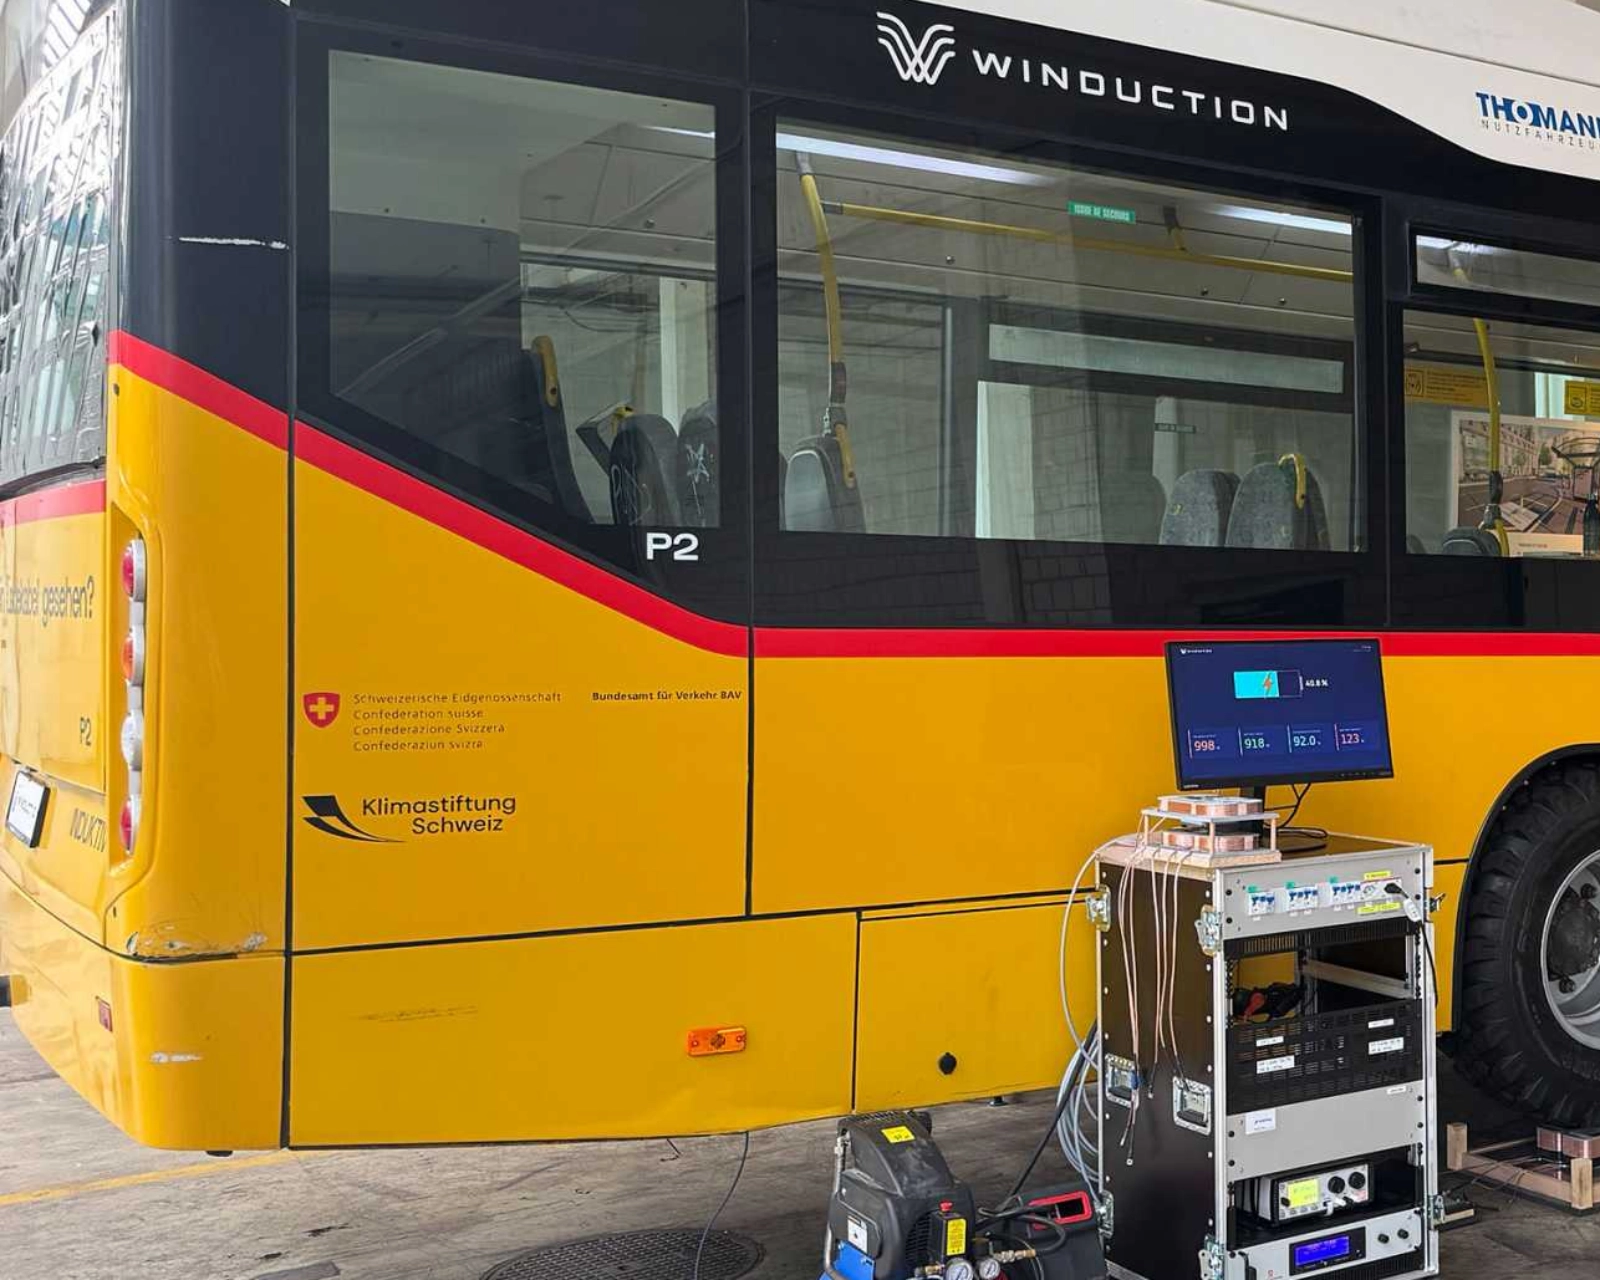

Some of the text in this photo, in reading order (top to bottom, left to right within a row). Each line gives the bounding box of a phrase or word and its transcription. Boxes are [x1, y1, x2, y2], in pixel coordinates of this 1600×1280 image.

[972, 49, 1288, 131] WINDUCTION
[646, 532, 699, 561] P2
[42, 575, 94, 628] gesehen?
[353, 692, 562, 704] Schweizerische Eidgenossenschaft
[592, 690, 742, 701] Bundesamt für Verkehr BAV
[80, 716, 91, 746] P2
[353, 723, 505, 735] Confederazione Svizzera
[1194, 739, 1215, 751] 998
[1244, 738, 1265, 749] 918
[1293, 735, 1316, 747] 92.0
[1341, 733, 1360, 745] 123
[353, 740, 445, 751] Confederaziun
[362, 795, 516, 816] Klimastiftung
[412, 815, 503, 835] Schweiz
